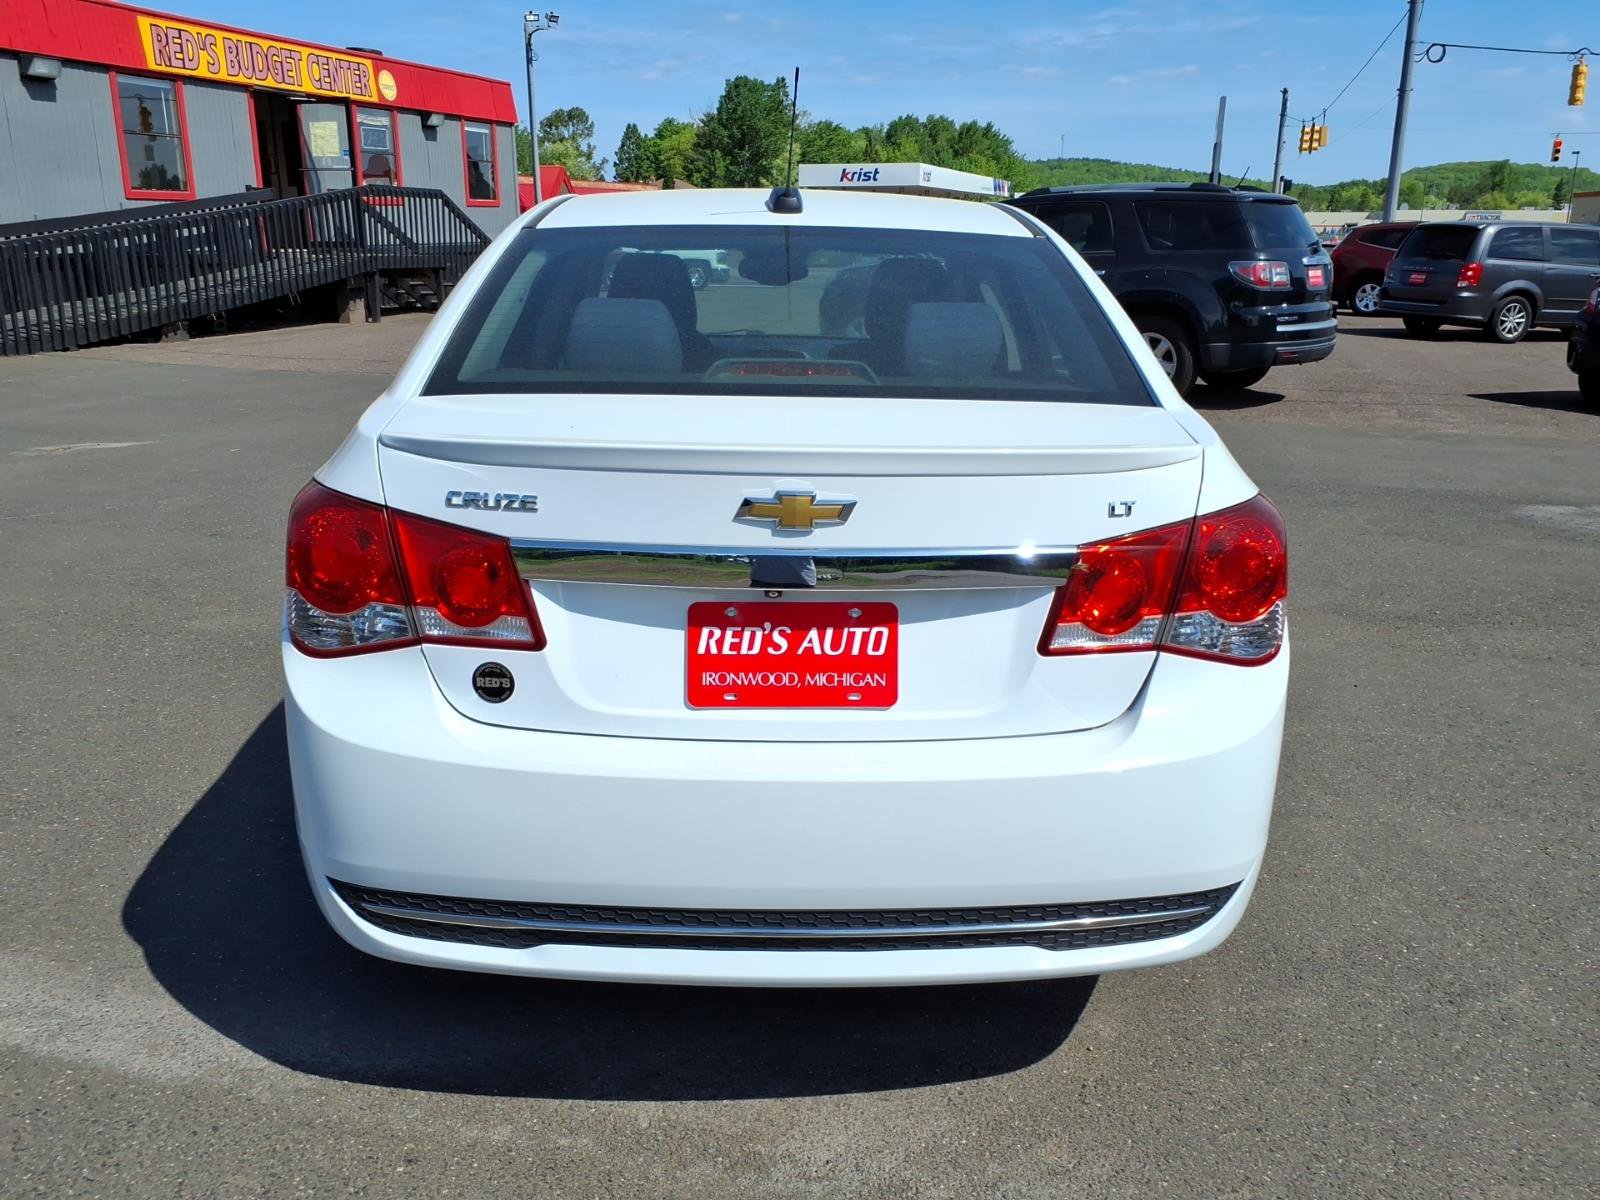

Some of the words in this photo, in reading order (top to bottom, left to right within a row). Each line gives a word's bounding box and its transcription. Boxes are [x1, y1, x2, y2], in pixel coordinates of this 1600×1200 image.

[150, 24, 221, 74] RED'S
[223, 37, 303, 87] BUDGET
[306, 53, 372, 97] CENTER
[840, 168, 880, 182] krist
[445, 491, 538, 513] CRUZE
[1108, 501, 1136, 518] LT
[697, 622, 792, 655] RED'S
[797, 626, 890, 656] AUTO
[476, 677, 511, 688] RED'S
[702, 671, 802, 688] IRONWOOD,
[805, 672, 887, 687] MICHIGAN
